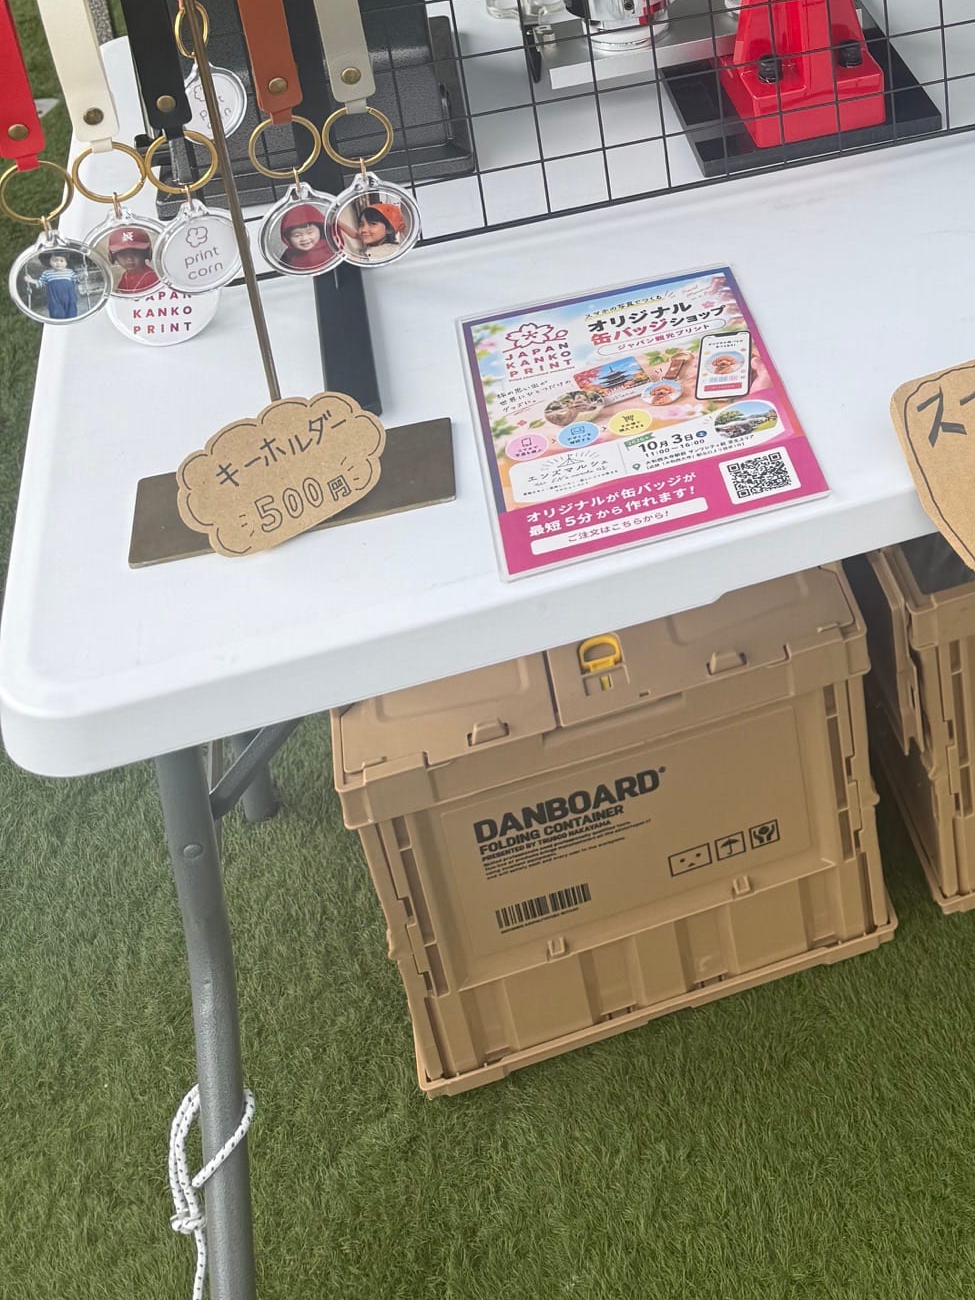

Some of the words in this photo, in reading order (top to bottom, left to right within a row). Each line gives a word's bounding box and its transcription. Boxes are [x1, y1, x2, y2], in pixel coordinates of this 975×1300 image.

[184, 246, 220, 268] print
[188, 261, 223, 280] corn
[133, 305, 192, 318] KANKO
[588, 302, 692, 332] オリジナル
[133, 321, 192, 334] PRINT
[591, 305, 726, 346] 缶バッジショップ
[505, 342, 568, 360] JAPAN
[506, 351, 571, 369] KANKO
[509, 359, 572, 377] PRINT
[216, 410, 347, 486] キーホルダー
[254, 474, 353, 534] 500円
[527, 472, 696, 523] オリジナルが缶バッジが
[473, 769, 660, 844] DANBOARD
[480, 829, 541, 855] FOLDING
[543, 805, 624, 836] CONTAINER
